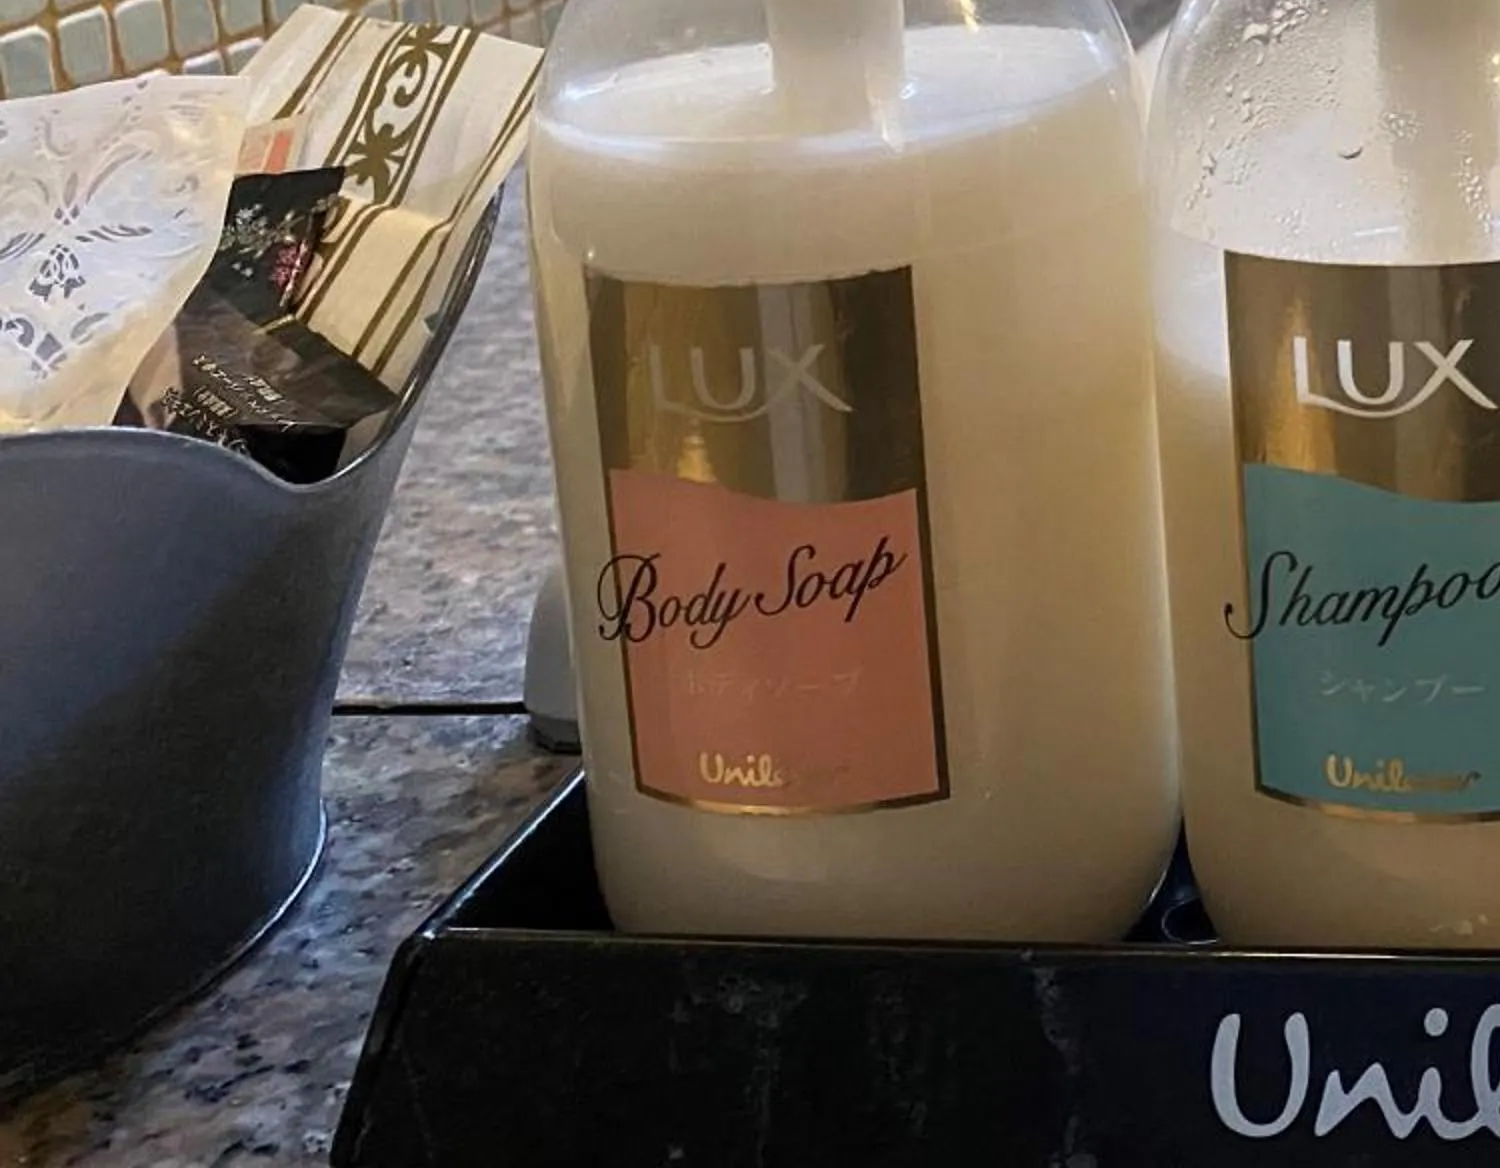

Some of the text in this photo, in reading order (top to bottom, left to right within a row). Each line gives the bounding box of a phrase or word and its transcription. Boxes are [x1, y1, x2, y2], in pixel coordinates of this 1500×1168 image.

[648, 341, 854, 423] LUX
[1293, 334, 1499, 419] LUX
[597, 535, 909, 650] Body Soap
[1318, 669, 1487, 707] シャンプー
